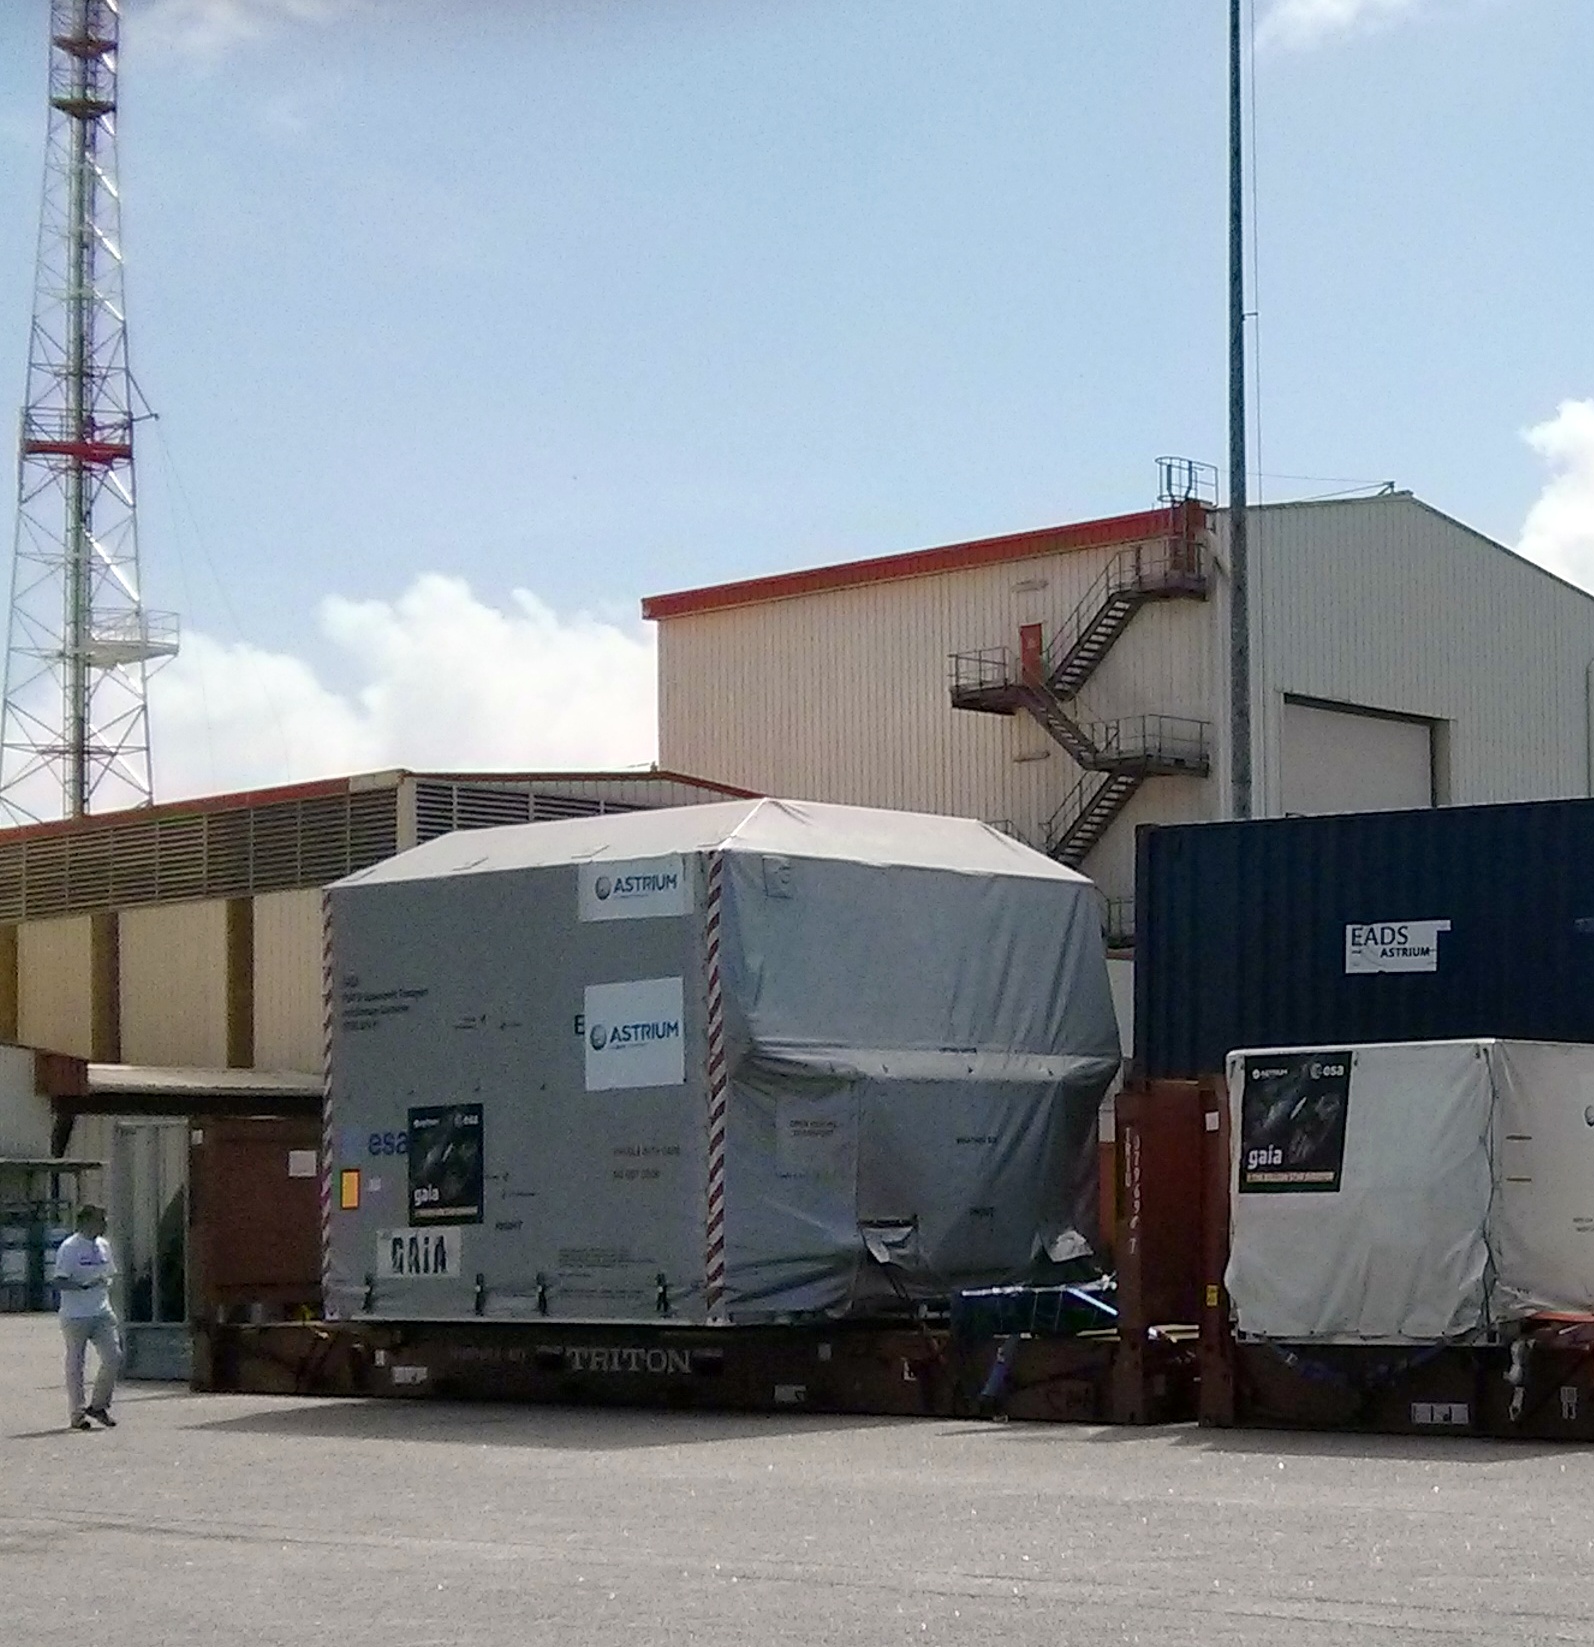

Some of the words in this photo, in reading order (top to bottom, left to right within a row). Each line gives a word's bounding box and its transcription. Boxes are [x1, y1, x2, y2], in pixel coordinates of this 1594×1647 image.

[613, 873, 678, 894] ASTRIUM
[1351, 925, 1408, 946] EADS
[1380, 946, 1430, 958] ASTRIUM
[610, 1019, 680, 1044] ASTRIUM
[368, 1131, 408, 1156] esa
[1247, 1144, 1283, 1170] gaia
[567, 1347, 692, 1374] TRITON
